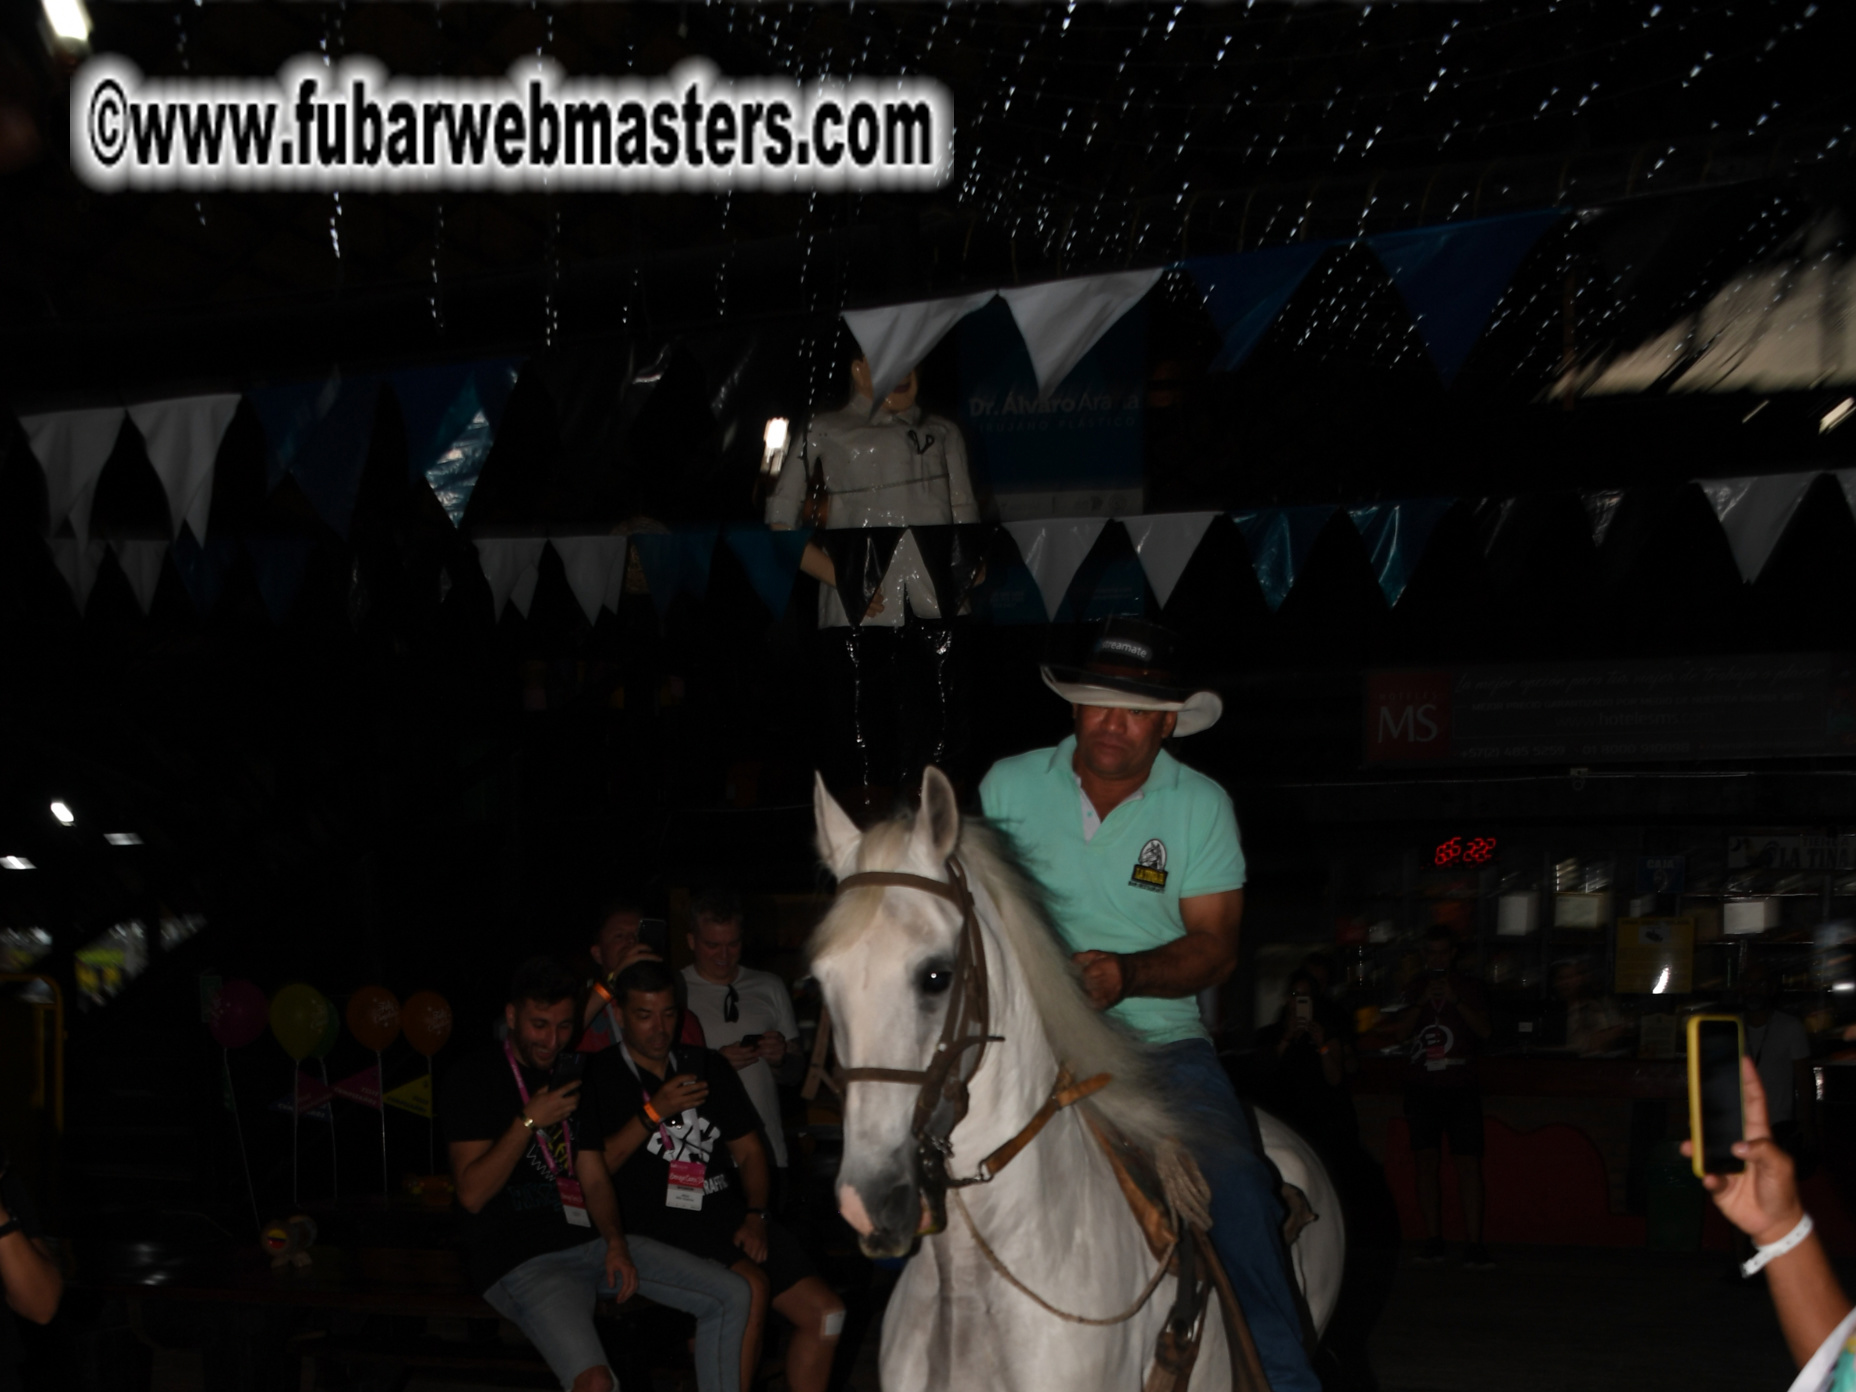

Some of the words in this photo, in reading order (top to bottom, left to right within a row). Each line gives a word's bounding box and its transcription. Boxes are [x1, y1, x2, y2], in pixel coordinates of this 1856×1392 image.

[969, 397, 999, 418] Dr.
[977, 419, 1049, 433] IRUJANO
[1377, 703, 1439, 743] MS
